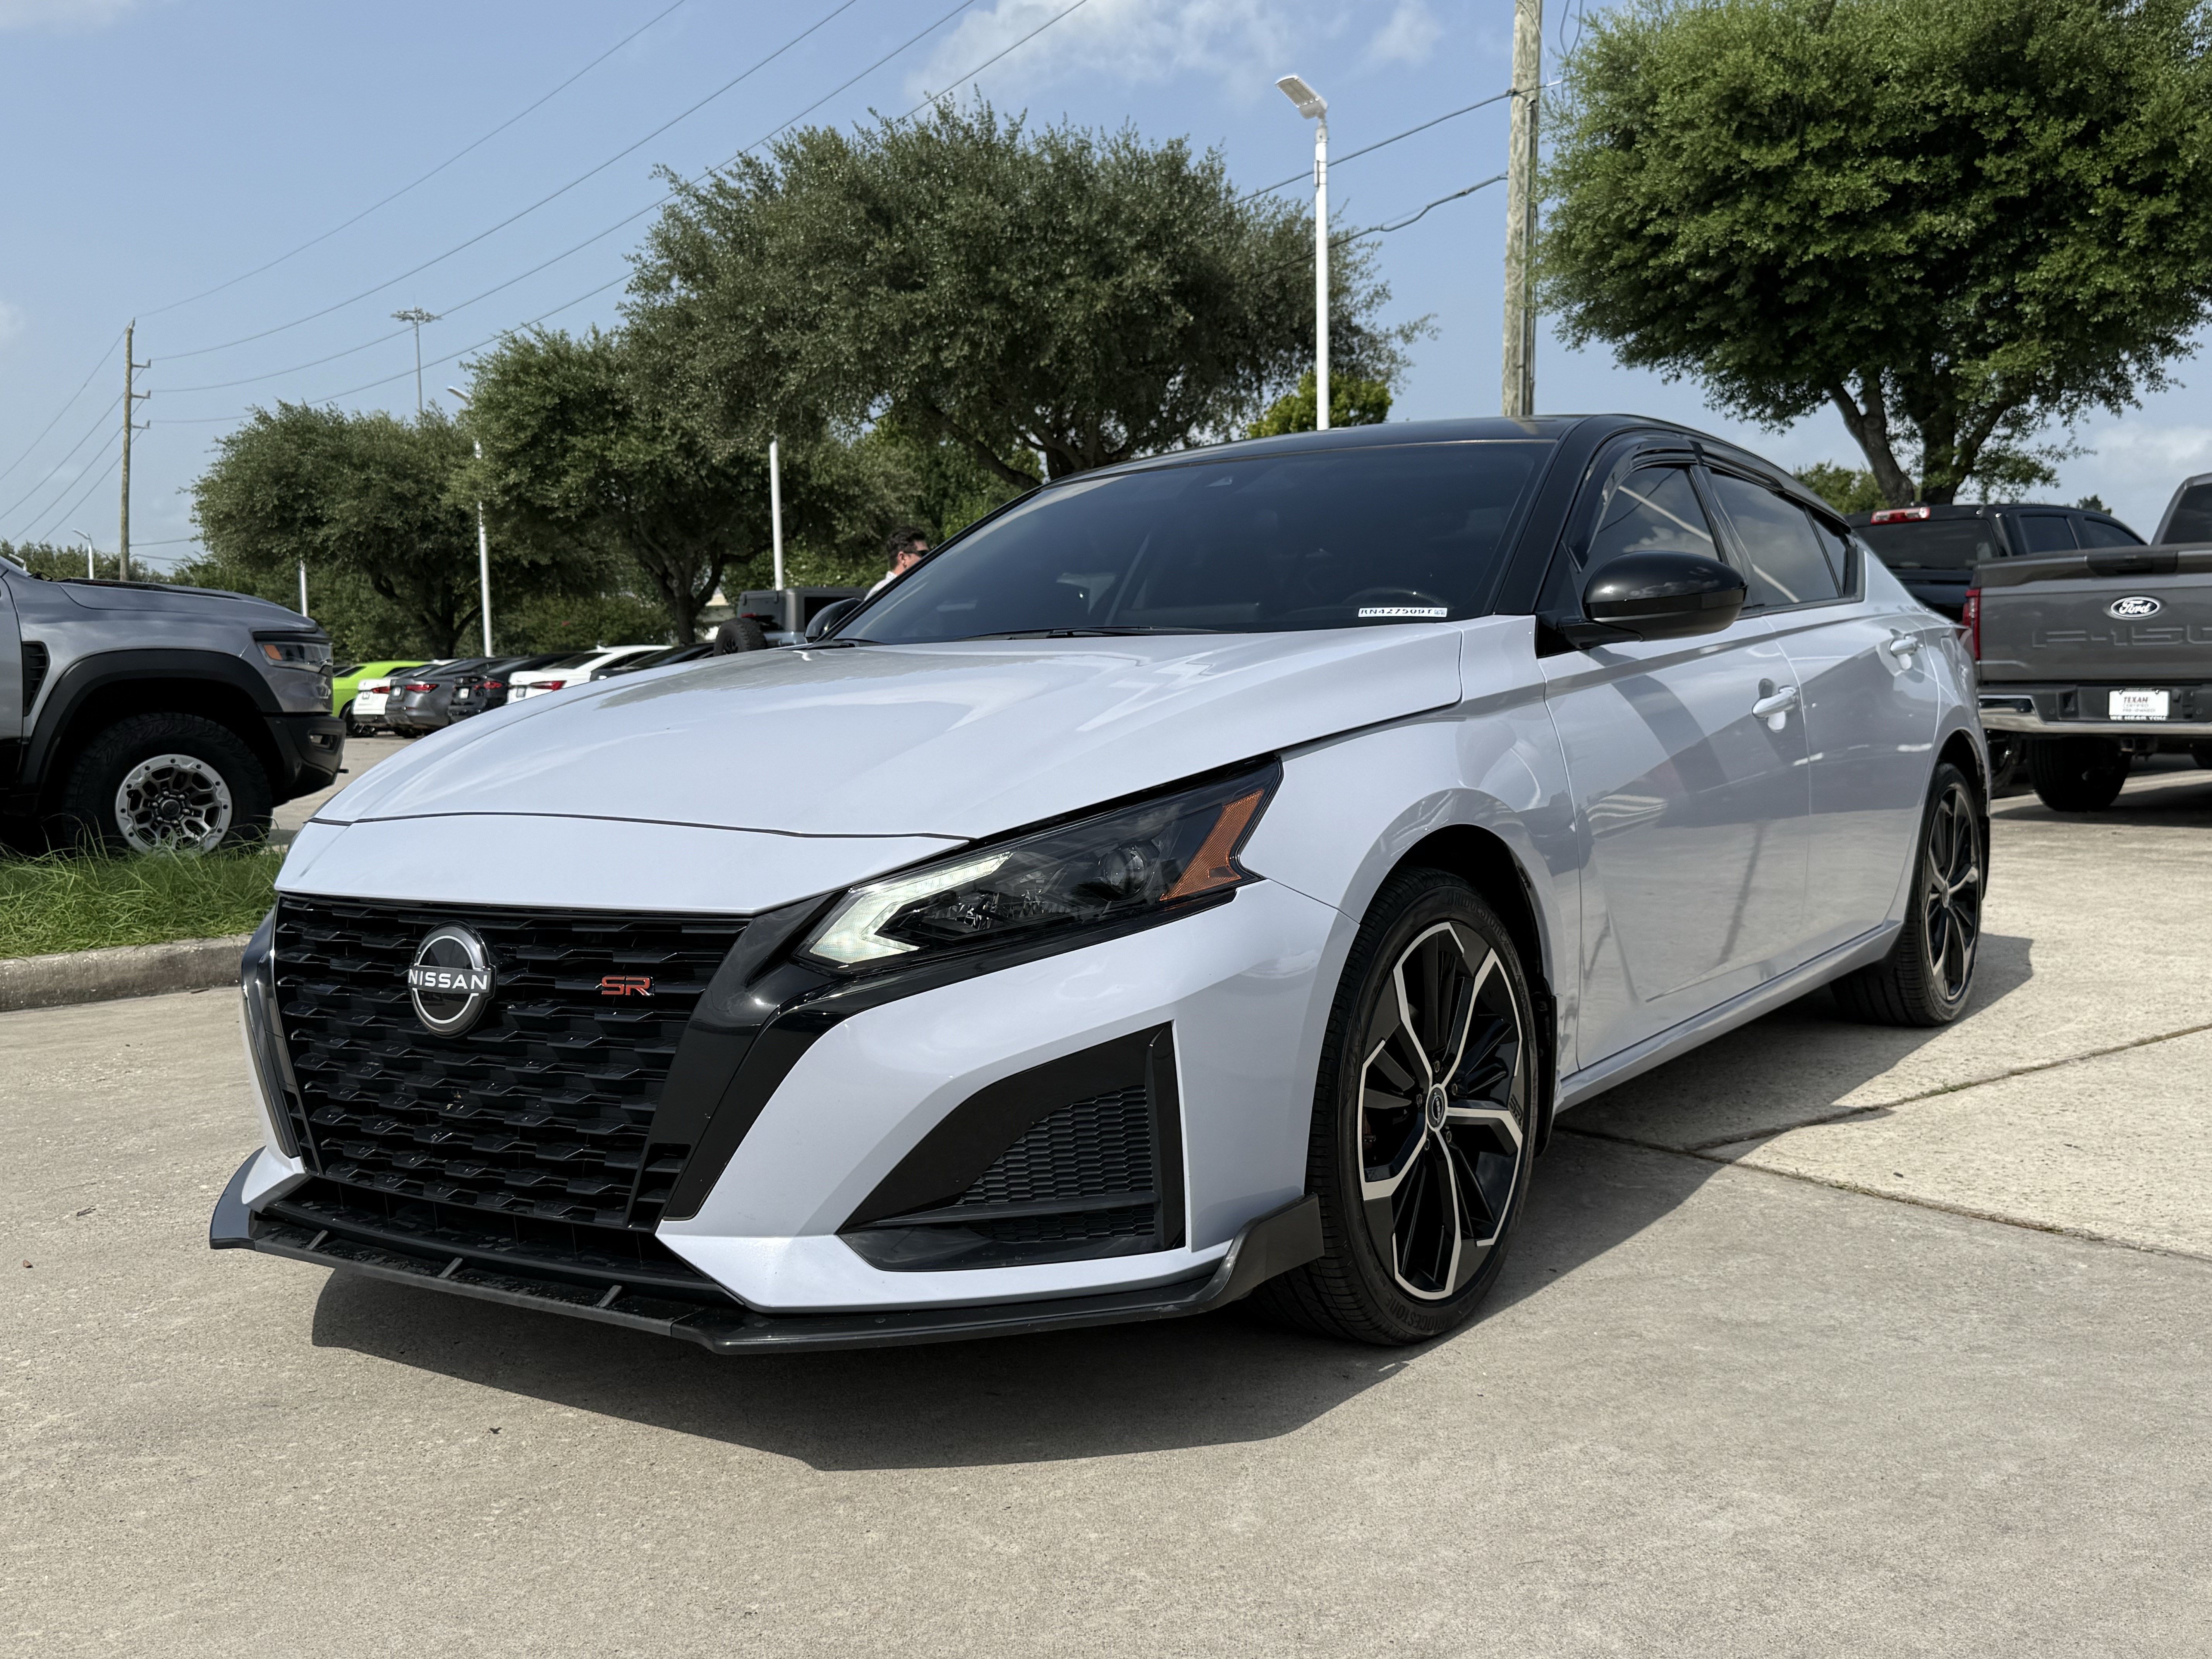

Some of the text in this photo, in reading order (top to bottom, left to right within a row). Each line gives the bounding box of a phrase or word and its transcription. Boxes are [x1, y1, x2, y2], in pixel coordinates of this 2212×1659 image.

[2119, 600, 2152, 614] Ford
[408, 969, 487, 990] NISSAN
[602, 976, 650, 996] SR
